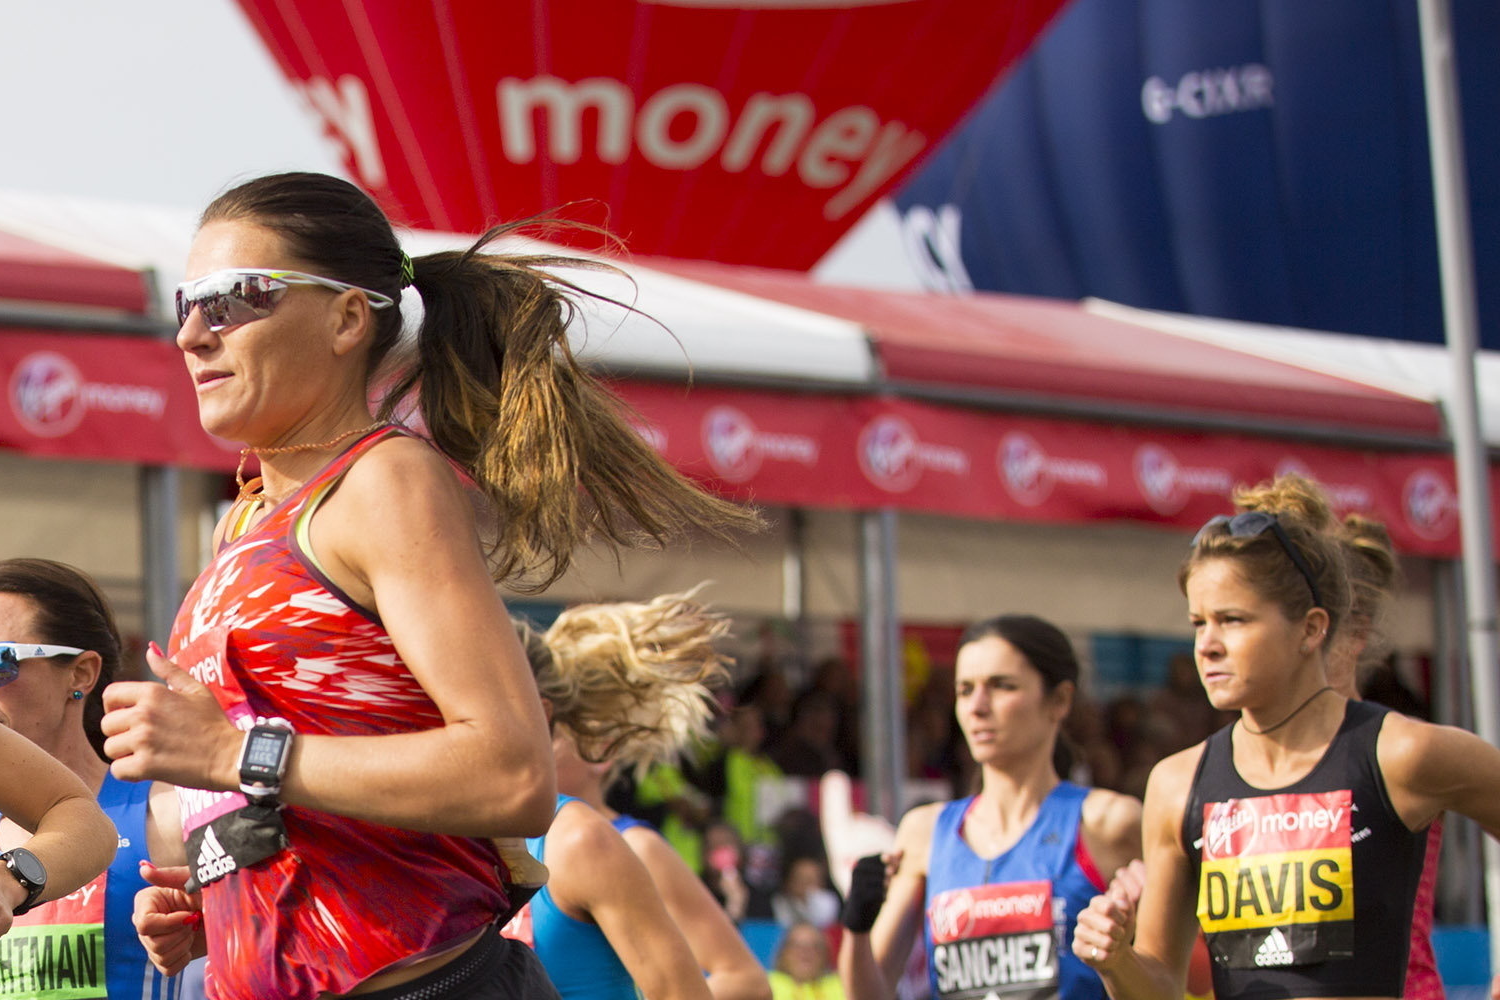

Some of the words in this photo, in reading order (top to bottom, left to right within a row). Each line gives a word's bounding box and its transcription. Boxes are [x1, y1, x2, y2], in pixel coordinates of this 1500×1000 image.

[496, 75, 926, 220] money
[1261, 808, 1344, 833] money
[197, 855, 236, 883] adidas
[1207, 859, 1343, 921] DAVIS
[973, 894, 1046, 918] money
[934, 932, 1054, 994] SANCHEZ
